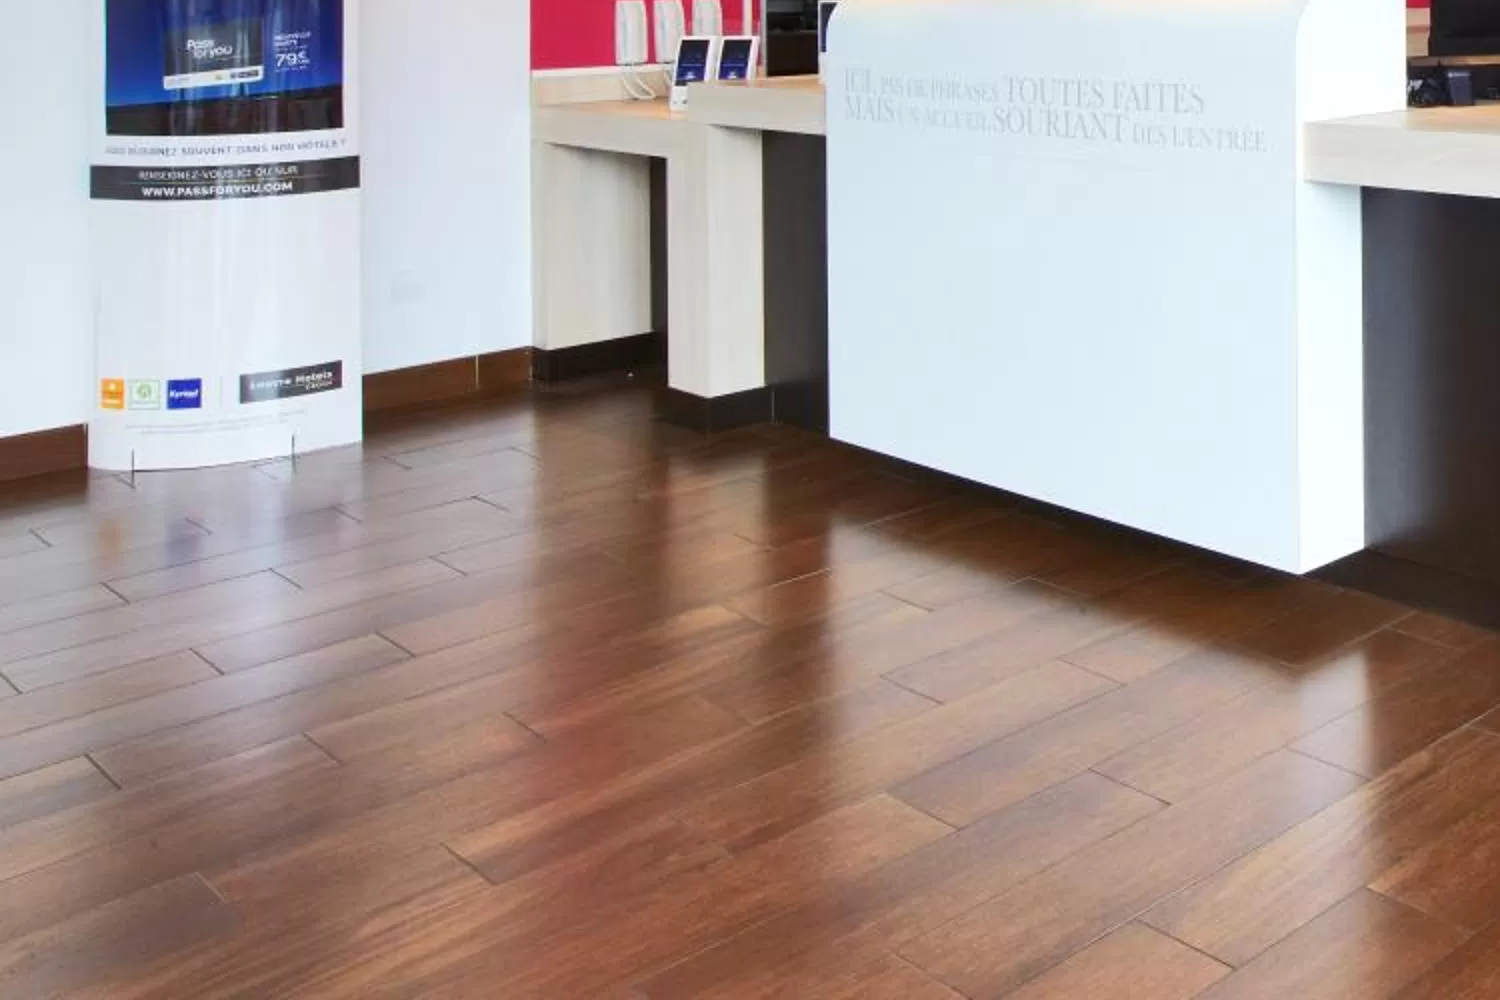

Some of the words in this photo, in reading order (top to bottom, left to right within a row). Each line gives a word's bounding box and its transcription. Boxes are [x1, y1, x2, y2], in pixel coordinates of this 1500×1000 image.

[1001, 74, 1104, 109] TOUTES
[1112, 80, 1205, 114] FAITES
[845, 95, 896, 123] MAIS
[994, 105, 1124, 143] SOURIANT
[141, 181, 293, 197] WWW.PASSFORYOU.COM
